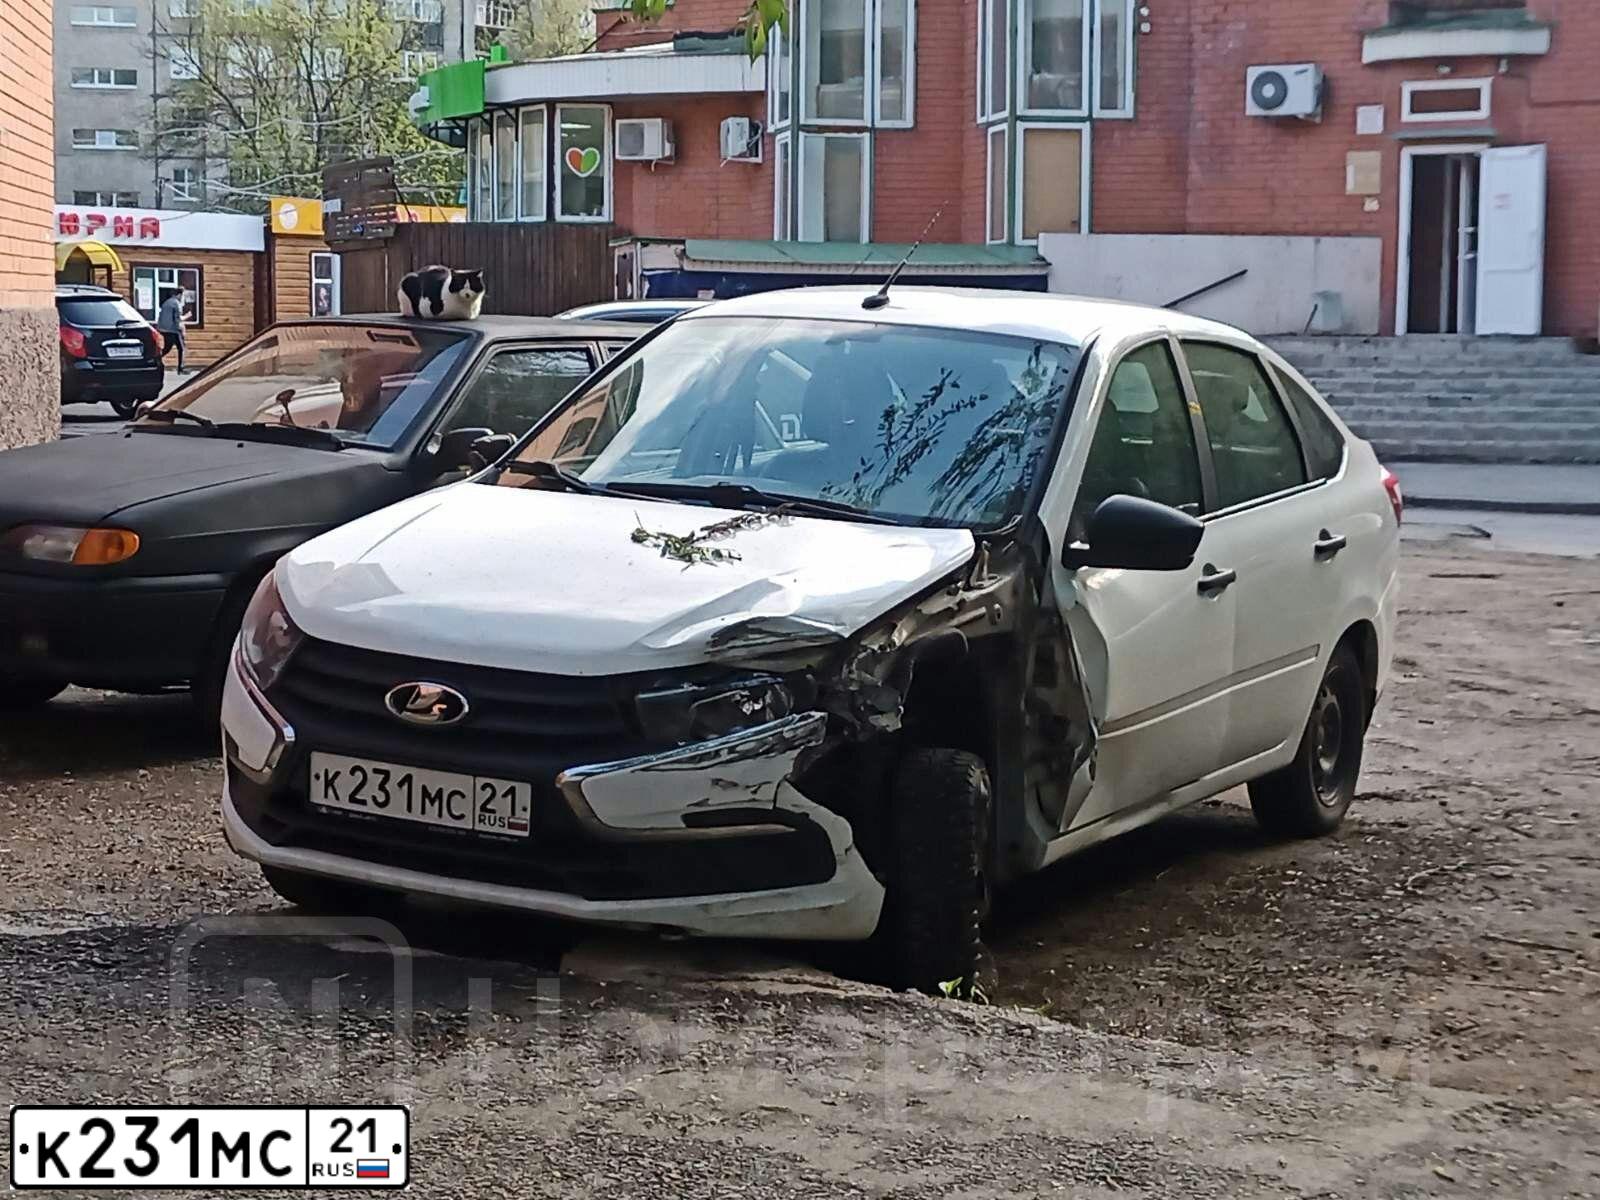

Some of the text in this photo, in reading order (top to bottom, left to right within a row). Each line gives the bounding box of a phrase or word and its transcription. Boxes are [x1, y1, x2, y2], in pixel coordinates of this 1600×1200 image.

[324, 765, 466, 820] К231МС
[479, 782, 516, 816] 21
[478, 814, 506, 828] RUS
